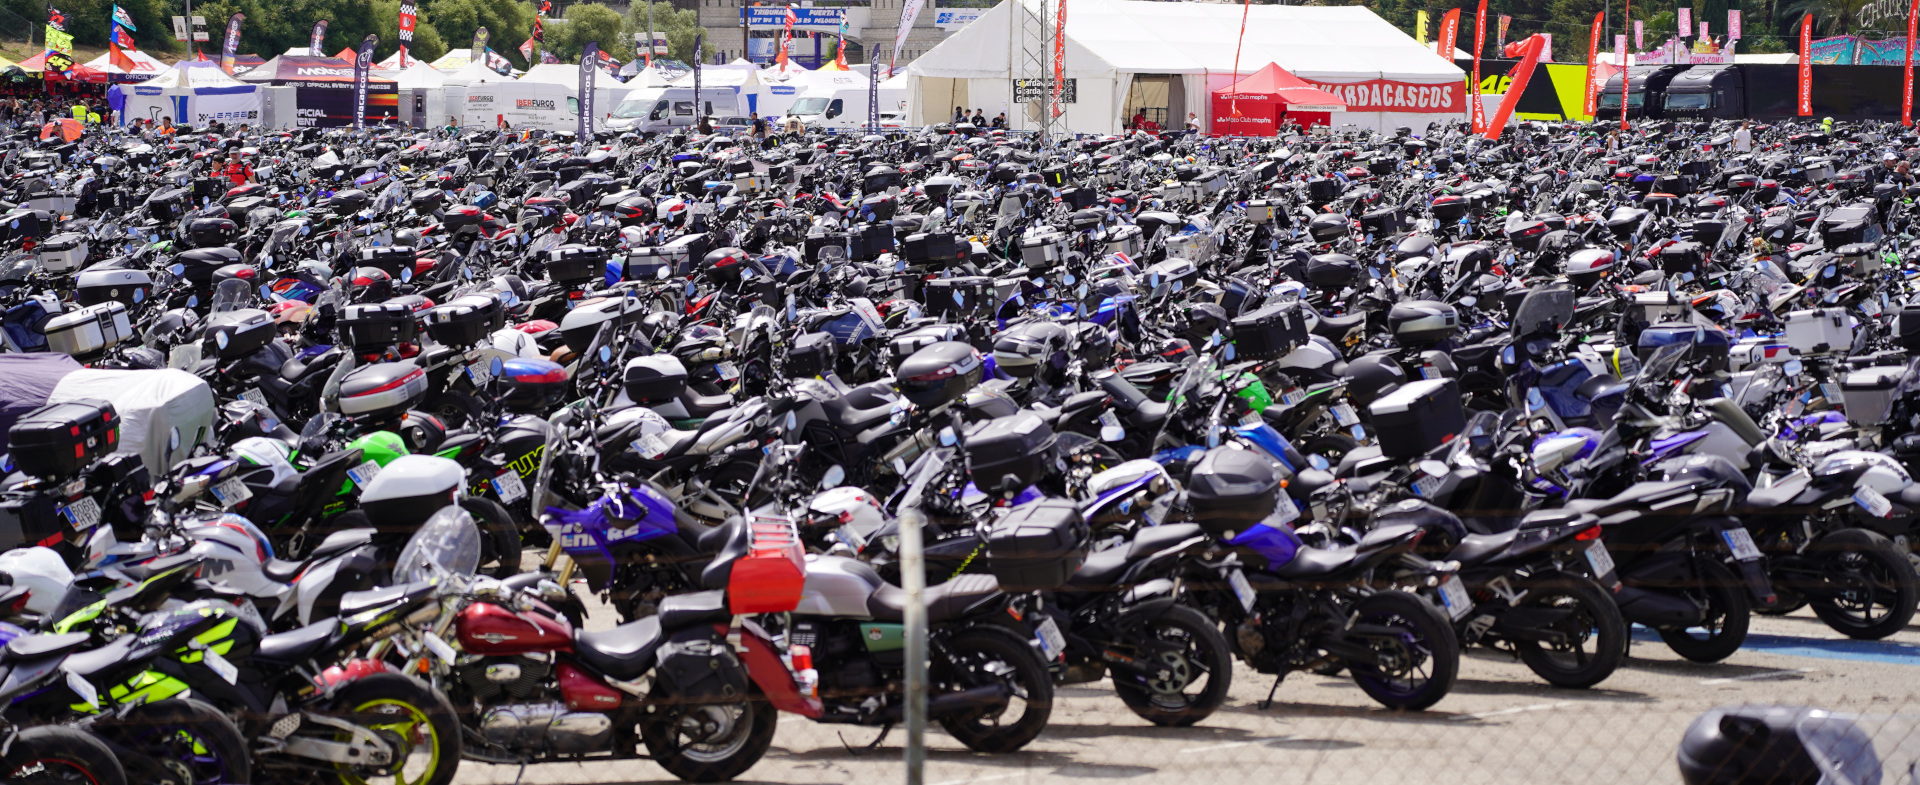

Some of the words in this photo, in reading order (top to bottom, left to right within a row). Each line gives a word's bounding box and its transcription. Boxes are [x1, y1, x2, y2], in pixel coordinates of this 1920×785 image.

[1445, 19, 1455, 54] mapfre
[1635, 50, 1666, 62] COMO-COMO
[1689, 56, 1724, 64] COMO-COMO
[1802, 79, 1810, 100] Moto
[515, 98, 555, 108] IBERFURGO
[296, 108, 327, 118] FICIAL
[297, 117, 318, 127] ENT
[243, 389, 262, 401] 7070
[71, 499, 96, 517] 6069
